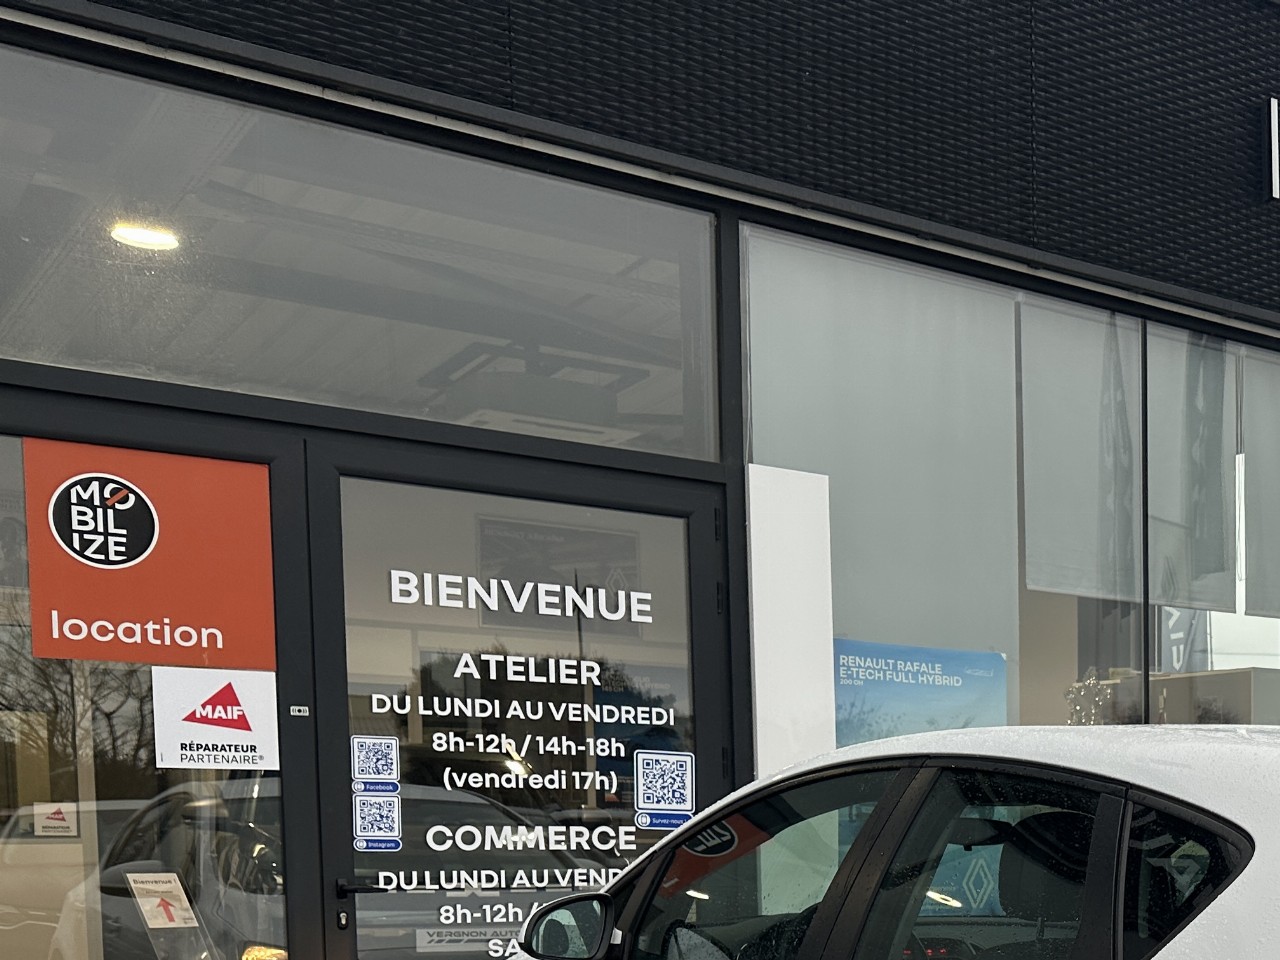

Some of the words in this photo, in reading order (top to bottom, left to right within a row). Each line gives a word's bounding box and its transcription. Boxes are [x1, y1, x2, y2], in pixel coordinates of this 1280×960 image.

[390, 568, 653, 624] BIENVENUE
[51, 609, 224, 649] location
[453, 652, 602, 687] ATELIER
[839, 655, 895, 671] RENAULT
[897, 660, 943, 675] RAFALE
[839, 667, 884, 681] E-TECH
[886, 671, 916, 684] FULL
[918, 673, 963, 687] HYBRID
[195, 704, 245, 721] MAIF
[371, 693, 411, 715] DU
[417, 695, 501, 719] LUNDI
[505, 699, 543, 721] AU
[548, 702, 676, 727] VENDREDI
[180, 740, 258, 754] RÉPARATEUR
[431, 731, 517, 754] 8h-12h
[535, 735, 626, 758] 14h-18h
[443, 766, 567, 792] (vendredi
[571, 769, 618, 794] 17h)
[426, 824, 637, 851] COMMERCE
[377, 870, 421, 891] DU
[424, 869, 506, 890] LUNDI
[512, 869, 550, 889] AU
[553, 867, 623, 889] VEND
[440, 902, 523, 924] 8h-12h
[427, 930, 487, 938] VERGNON
